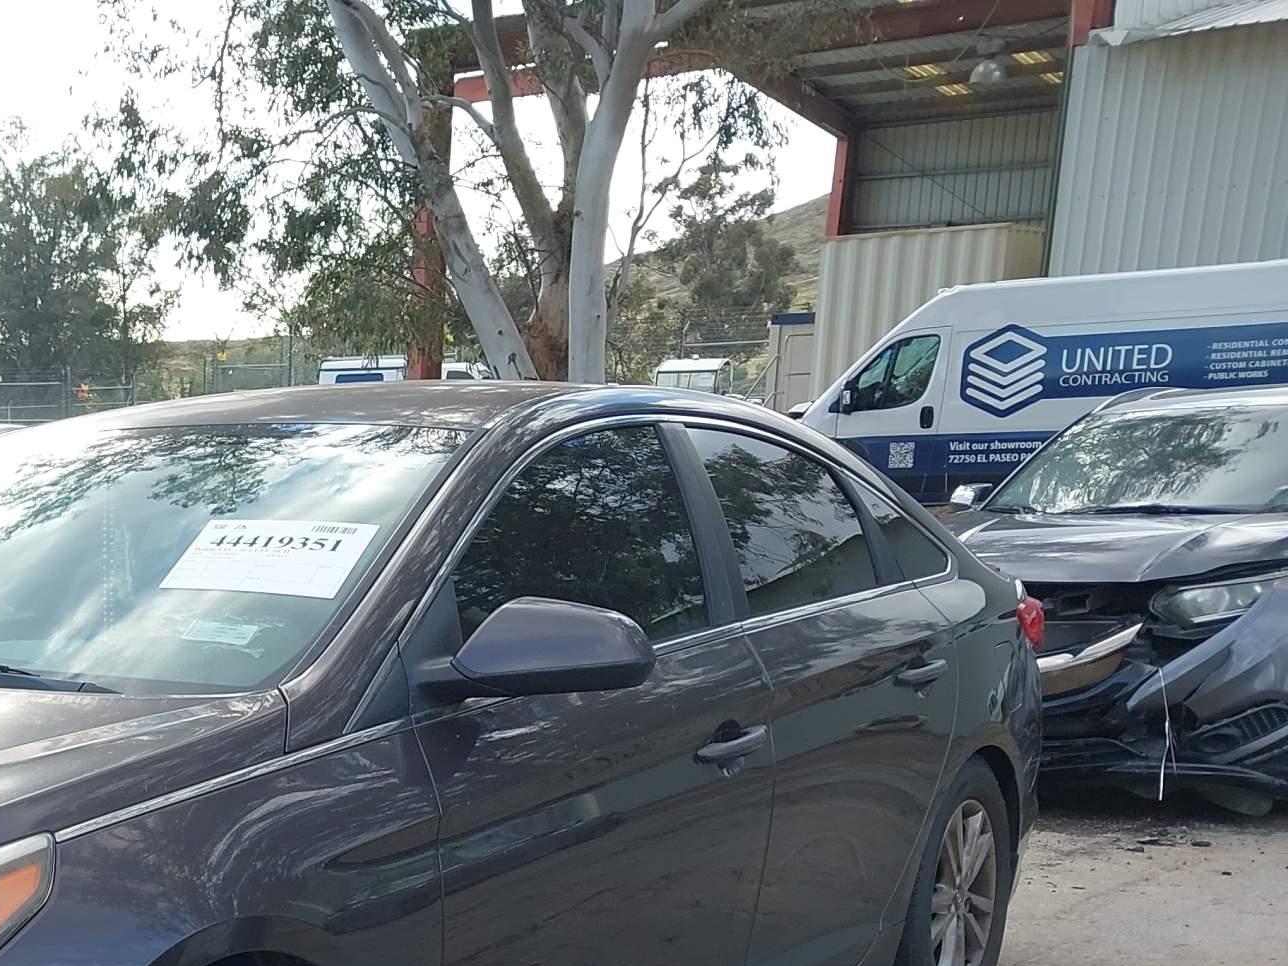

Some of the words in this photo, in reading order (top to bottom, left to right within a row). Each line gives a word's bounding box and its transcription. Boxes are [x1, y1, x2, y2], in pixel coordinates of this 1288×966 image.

[1212, 340, 1269, 350] RESIDENTIAL
[1061, 343, 1173, 373] UNITED
[1210, 350, 1268, 360] RESIDENTIAL
[1209, 361, 1247, 370] CUSTOM
[1059, 370, 1169, 387] CONTRACTING
[1208, 372, 1238, 380] PUBLIC
[1238, 370, 1269, 378] WORKS
[949, 441, 970, 451] Visit
[990, 440, 1042, 449] showroom
[948, 454, 976, 463] 72750
[977, 453, 987, 462] EL
[989, 452, 1019, 462] PASEO
[210, 534, 343, 552] 44419351
